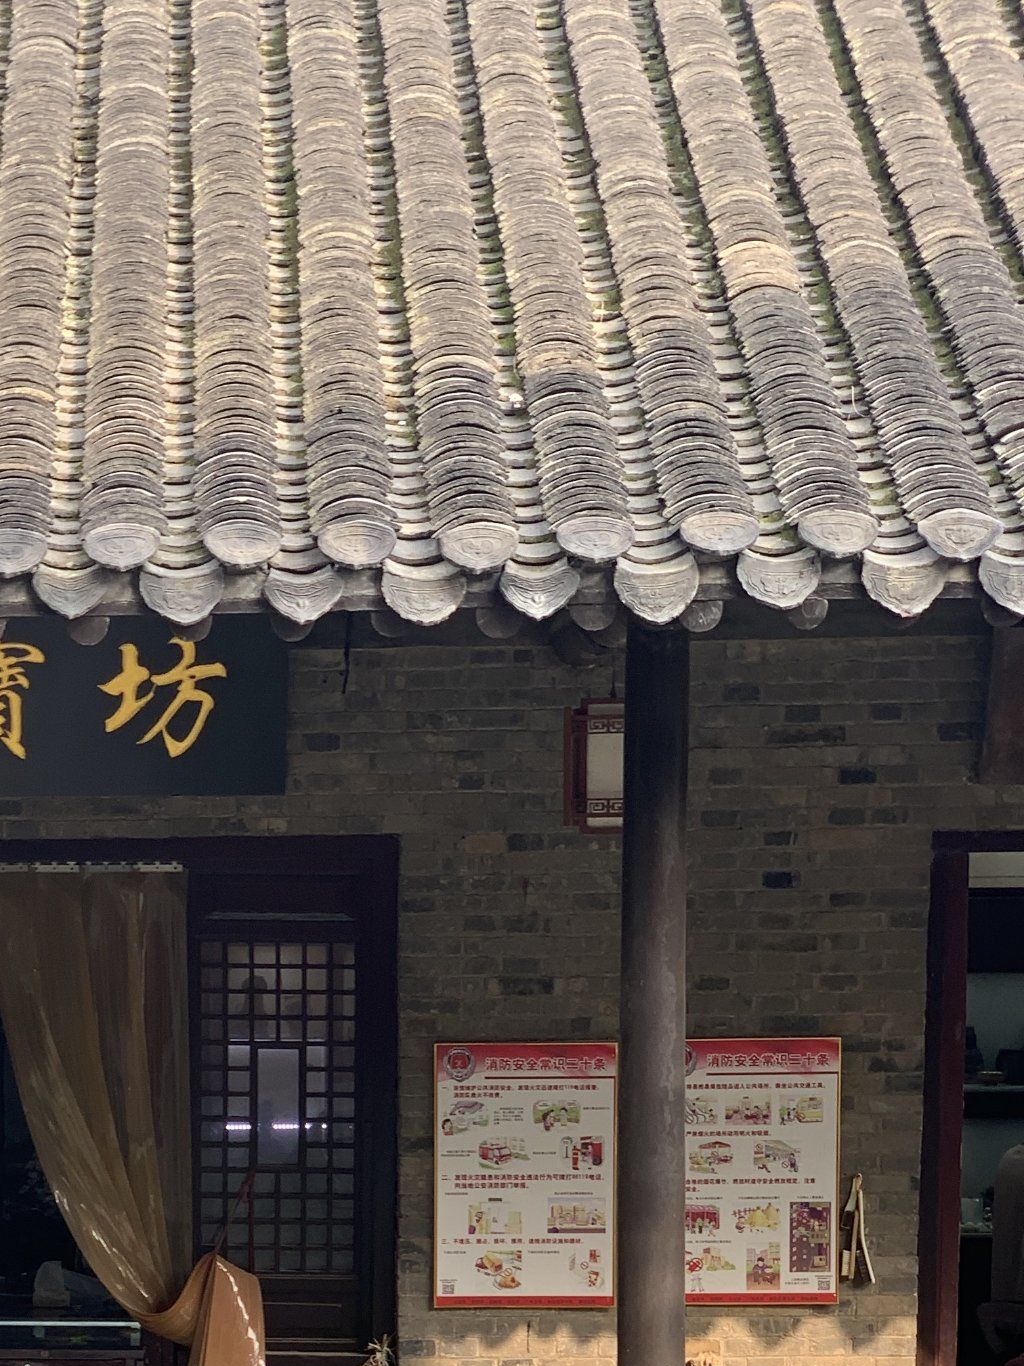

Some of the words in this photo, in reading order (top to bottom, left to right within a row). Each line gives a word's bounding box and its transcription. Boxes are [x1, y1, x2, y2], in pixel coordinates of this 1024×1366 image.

[484, 1056, 609, 1072] 消防安全常识二十条
[706, 1052, 831, 1068] 消防安全常识二十条
